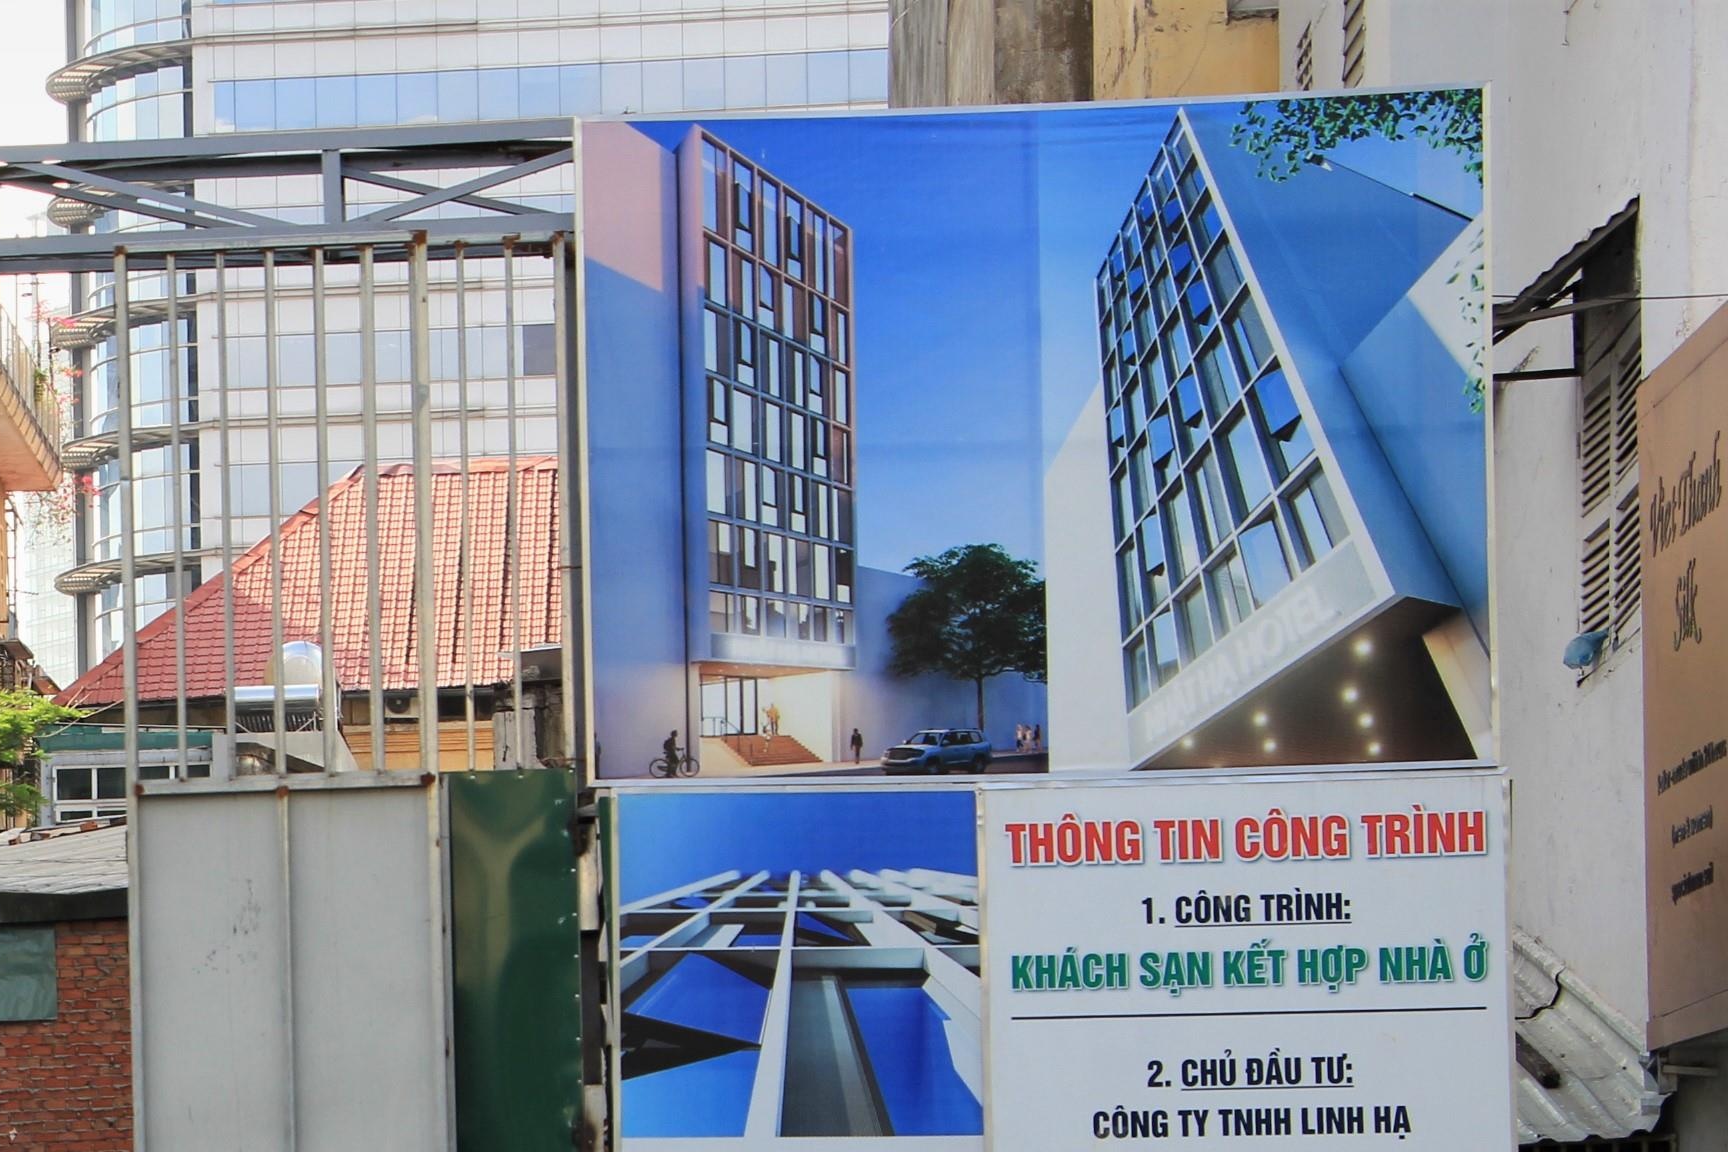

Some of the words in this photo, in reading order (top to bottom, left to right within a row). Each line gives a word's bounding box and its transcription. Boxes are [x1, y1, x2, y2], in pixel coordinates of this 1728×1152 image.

[1673, 558, 1702, 652] Silk
[1006, 813, 1141, 866] THÔNG
[1155, 817, 1220, 861] TIN
[1235, 809, 1349, 859] CÔNG
[1362, 804, 1485, 856] TRÌNH
[1142, 897, 1165, 925] 1.
[1175, 890, 1250, 923] CÔNG
[1261, 887, 1351, 921] TRÌNH:
[1011, 947, 1127, 990] KHÁCH
[1140, 952, 1210, 996] SẠN
[1223, 940, 1286, 985] KẾT
[1298, 947, 1366, 992] HỢP
[1379, 939, 1452, 982] NHÀ
[1464, 933, 1488, 981] Ở
[1148, 1061, 1171, 1088] 2.
[1181, 1050, 1235, 1087] CHỦ
[1246, 1049, 1301, 1085] ĐẦU
[1311, 1054, 1353, 1084] TƯ:
[1093, 1105, 1168, 1138] CÔNG
[1178, 1110, 1208, 1137] TY
[1218, 1107, 1292, 1136] TNHH
[1301, 1106, 1364, 1134] LINH
[1374, 1106, 1411, 1140] HẠ
